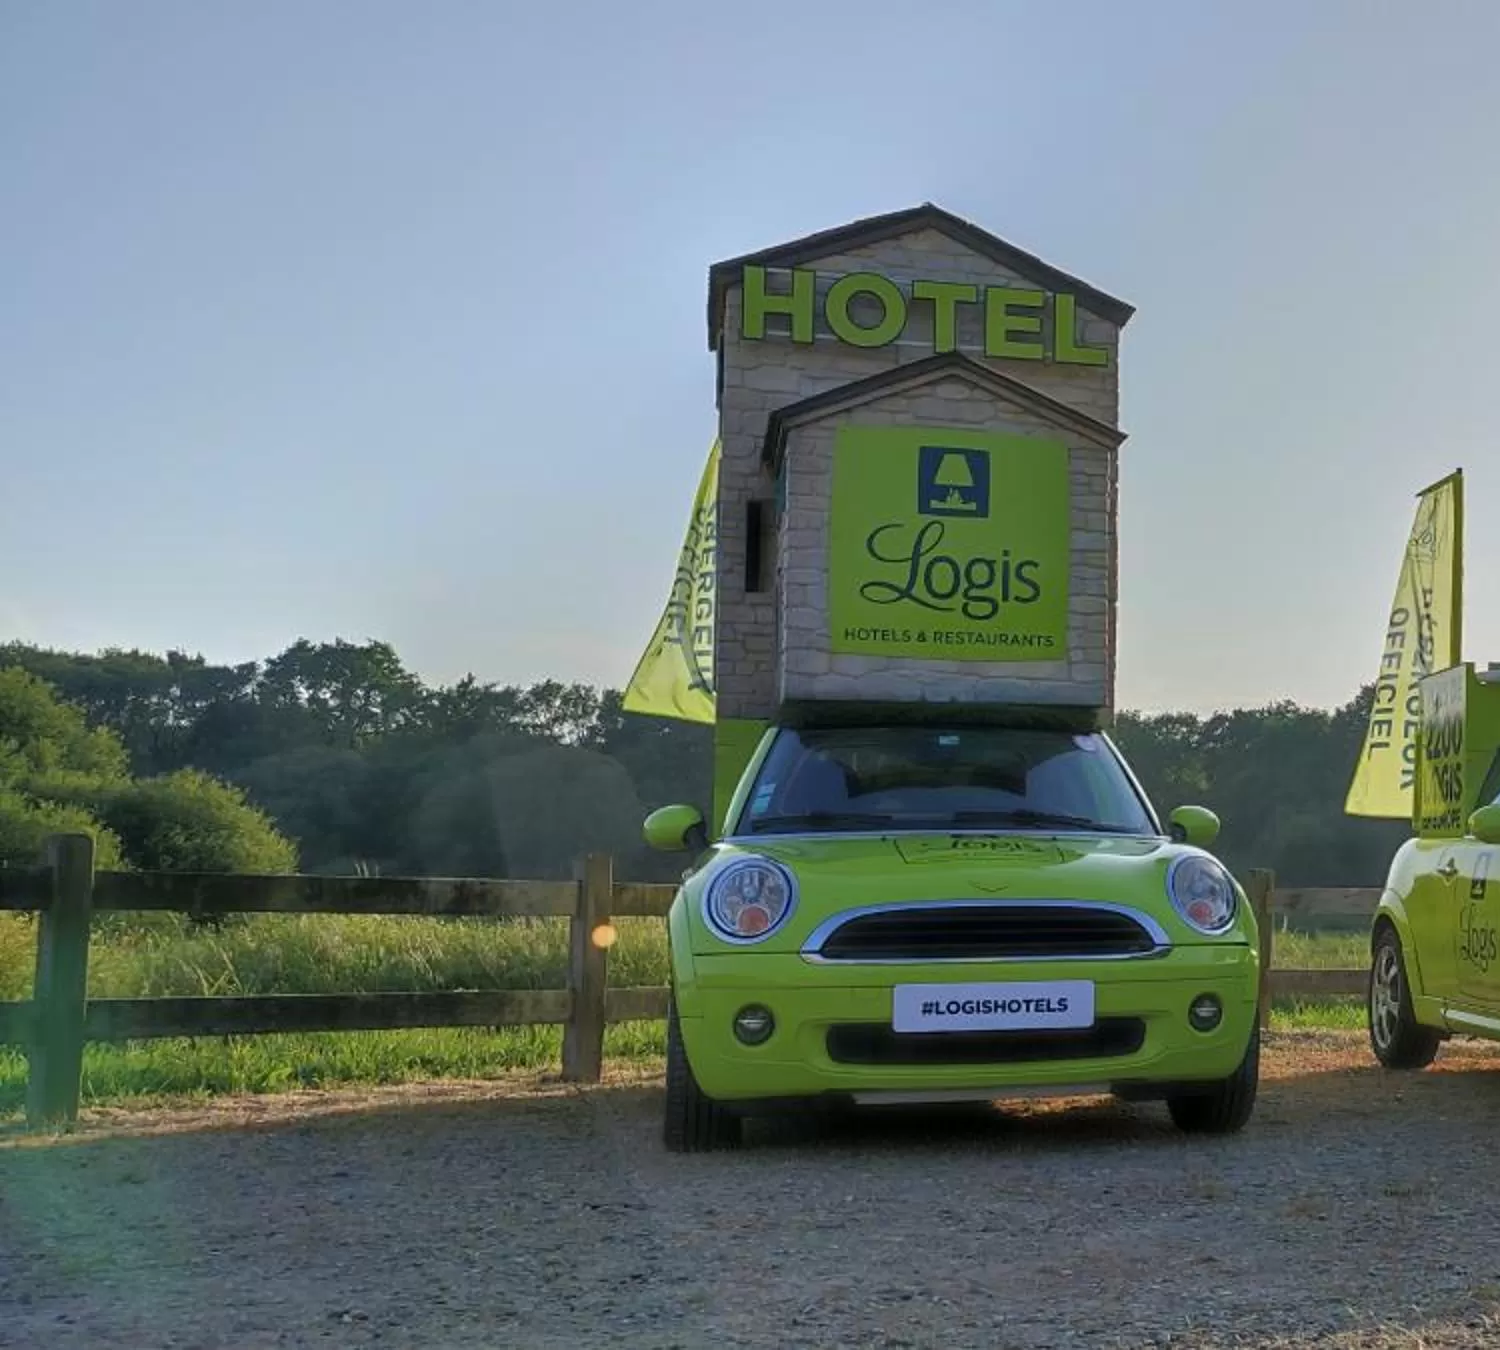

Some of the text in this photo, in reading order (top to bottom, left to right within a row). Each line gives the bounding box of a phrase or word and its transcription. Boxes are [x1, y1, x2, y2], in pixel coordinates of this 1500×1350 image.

[741, 264, 1109, 367] HOTEL
[859, 519, 1041, 622] Logis
[844, 627, 1055, 648] HOTELS & RESTAURANTS
[1368, 606, 1410, 762] OFFICIEL
[921, 998, 1069, 1017] #LOGISHOTELS
